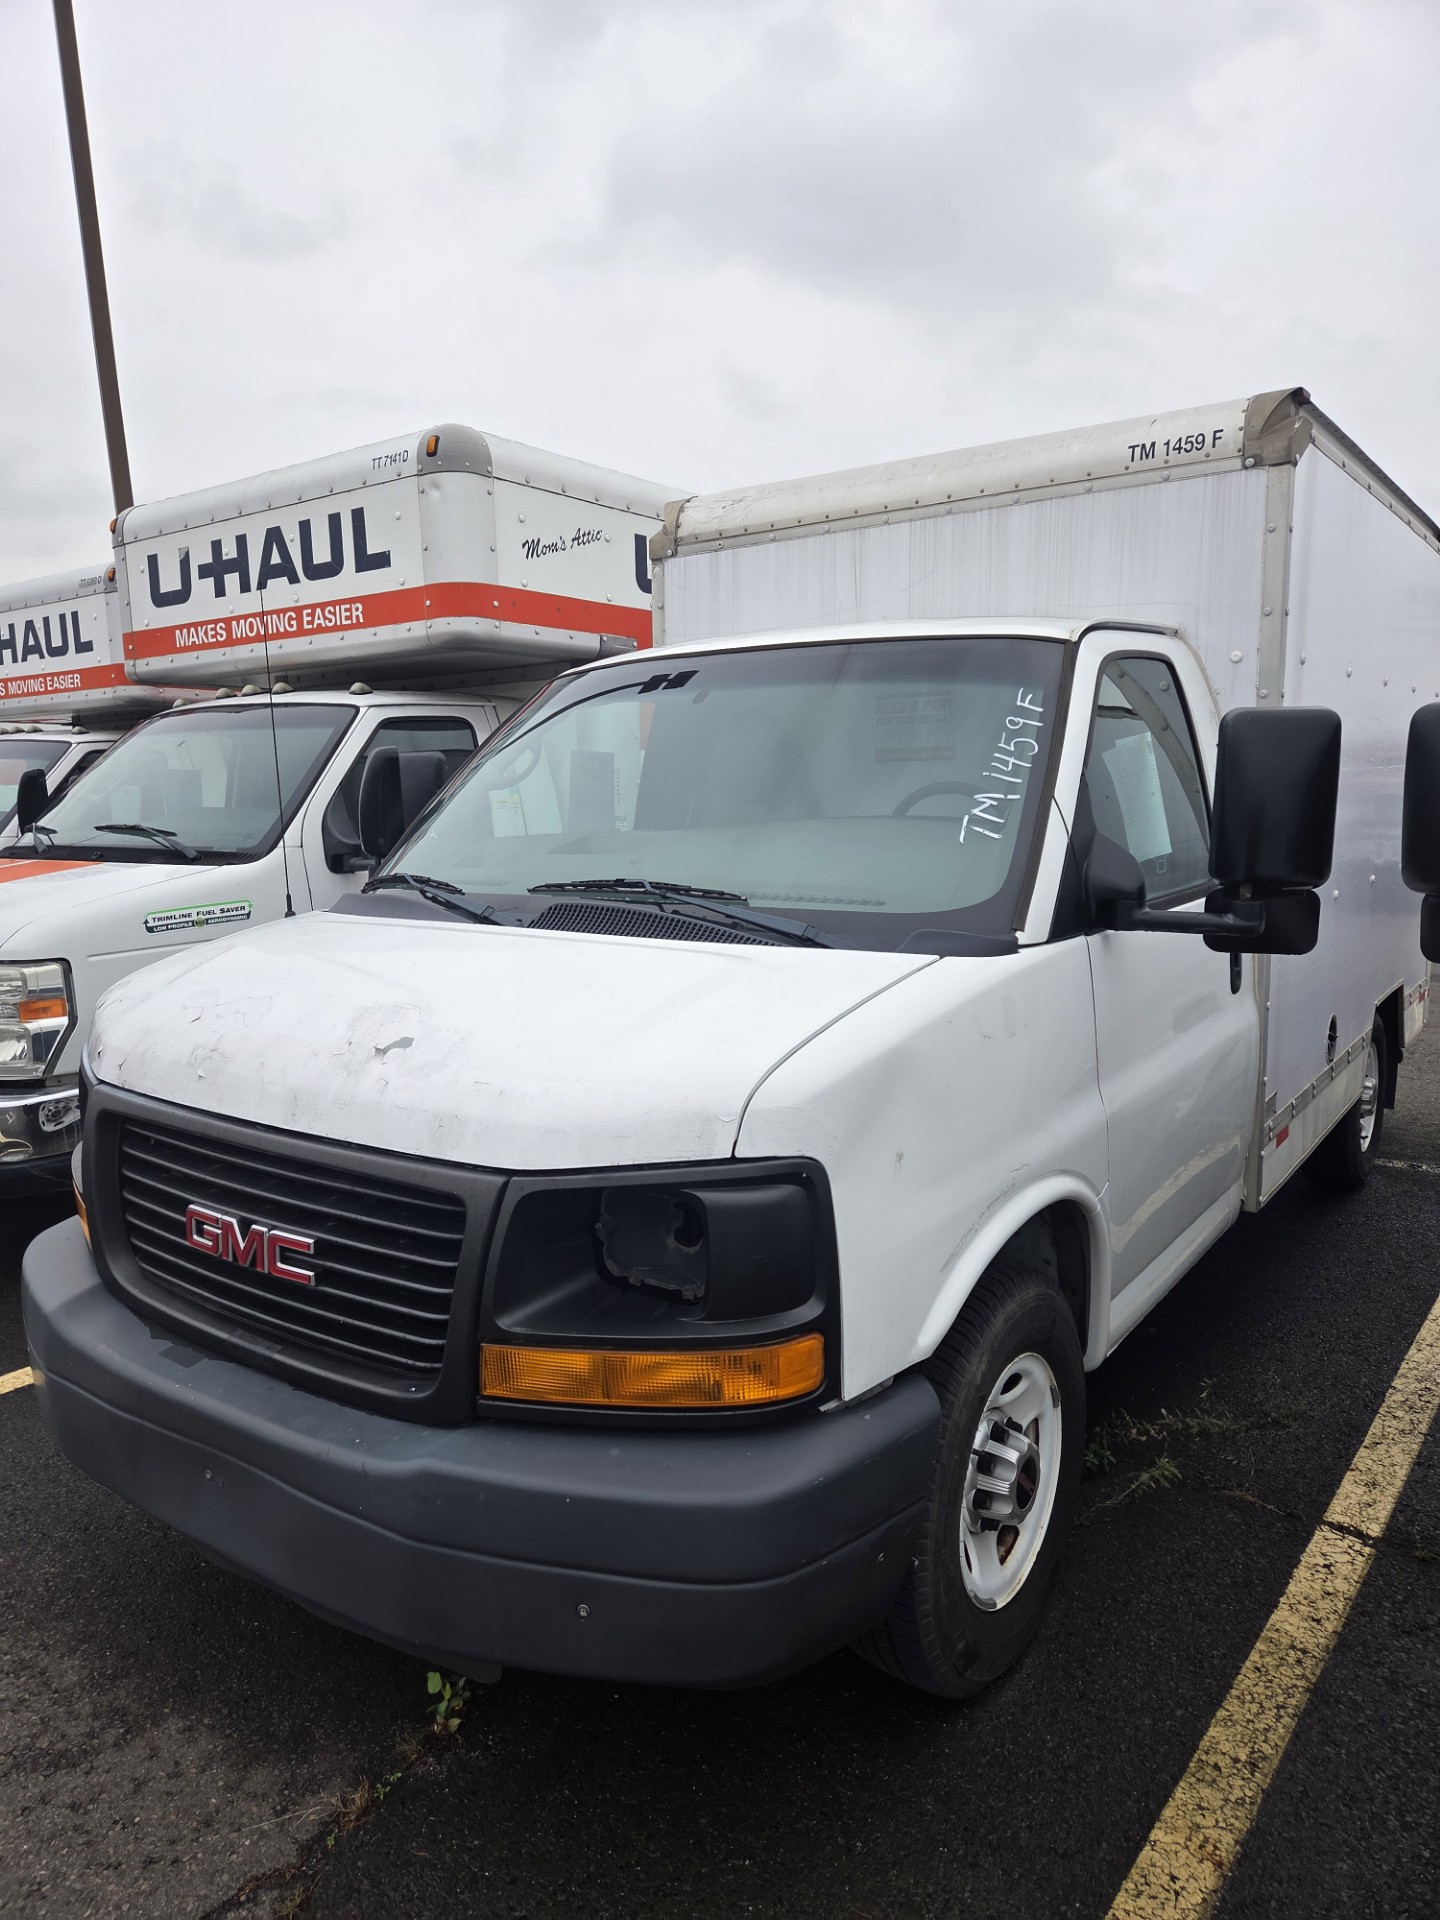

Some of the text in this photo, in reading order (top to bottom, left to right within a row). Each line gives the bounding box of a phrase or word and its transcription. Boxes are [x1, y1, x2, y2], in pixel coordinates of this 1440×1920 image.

[1128, 428, 1224, 462] TM 1459 F
[371, 456, 383, 471] TT
[146, 506, 391, 609] U-HAUL
[521, 527, 603, 560] Mom's Attic
[0, 610, 94, 666] HAUL
[175, 603, 364, 648] MAKES MOVING EASIER
[8, 679, 45, 695] MOVING
[46, 673, 81, 691] EASIER
[152, 905, 246, 923] TRIMLINE FUEL SAVER
[168, 921, 193, 930] PROFILE
[185, 1204, 315, 1286] GMC
